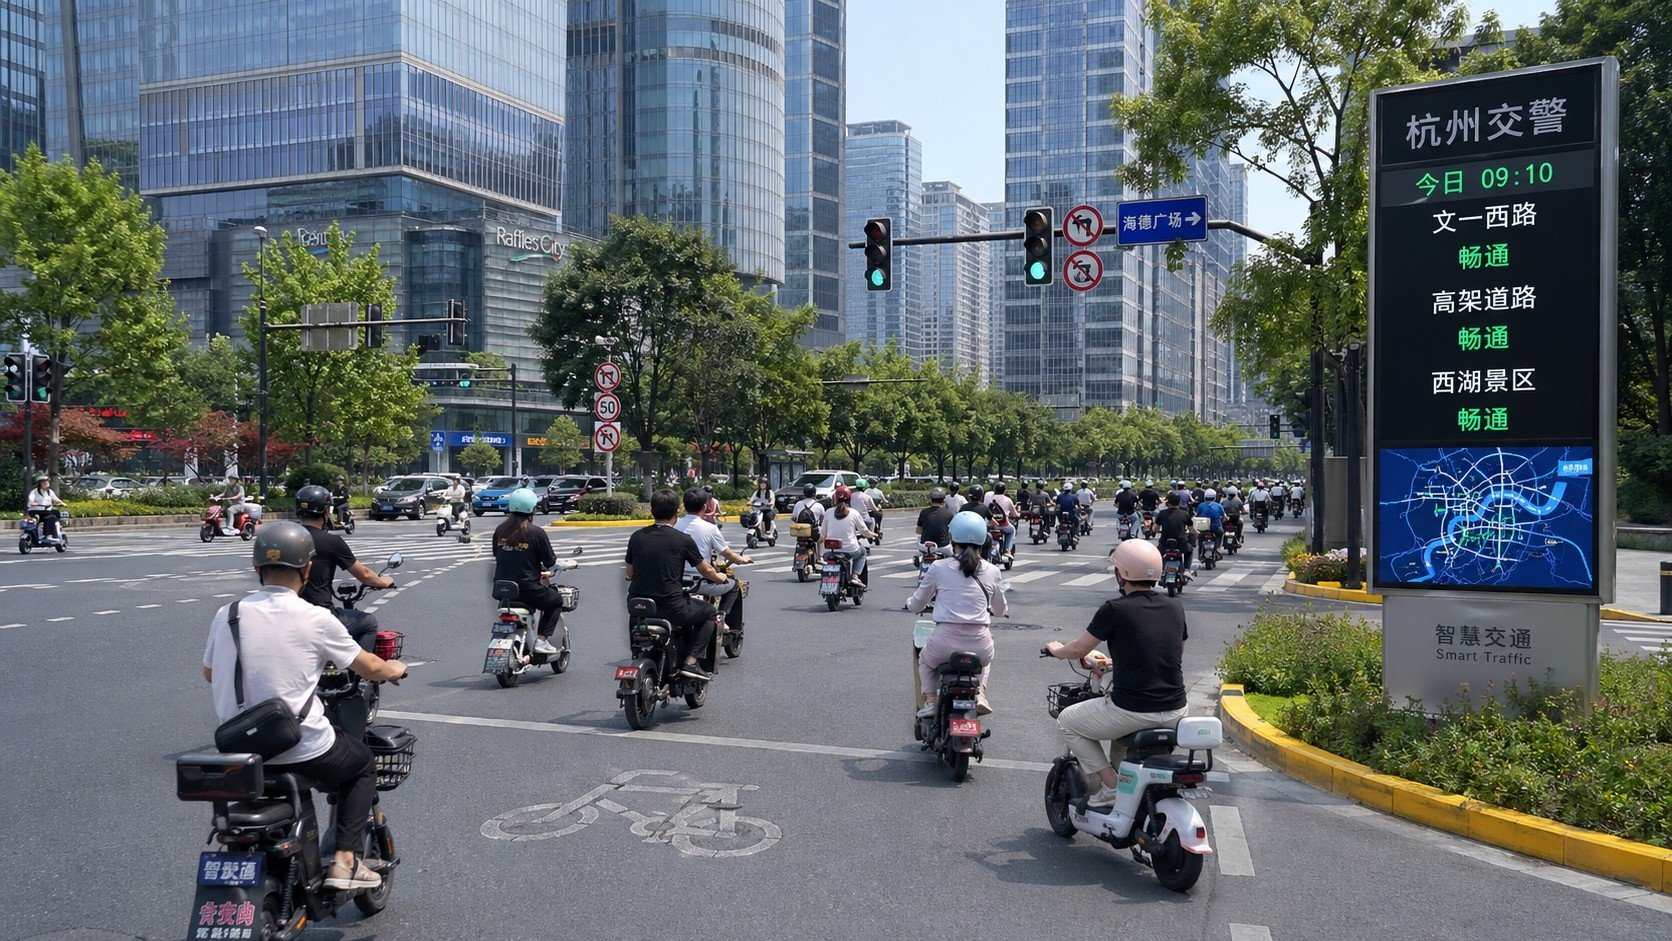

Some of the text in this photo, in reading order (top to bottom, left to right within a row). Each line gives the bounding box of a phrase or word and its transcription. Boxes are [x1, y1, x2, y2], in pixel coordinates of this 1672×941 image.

[1405, 96, 1567, 150] 杭州交警
[1415, 161, 1553, 197] 今日 09:10
[1122, 211, 1182, 232] 海德广场
[1432, 201, 1538, 234] 文一西路
[496, 226, 566, 260] Raffles City
[1458, 242, 1510, 270] 畅通
[1431, 284, 1537, 315] 高架道路
[1457, 325, 1509, 351] 畅通
[1431, 367, 1536, 395] 西湖景区
[600, 401, 615, 414] 50
[1457, 407, 1509, 432] 畅通
[1435, 623, 1532, 650] 智慧交通
[1436, 648, 1532, 666] Smart Traffic
